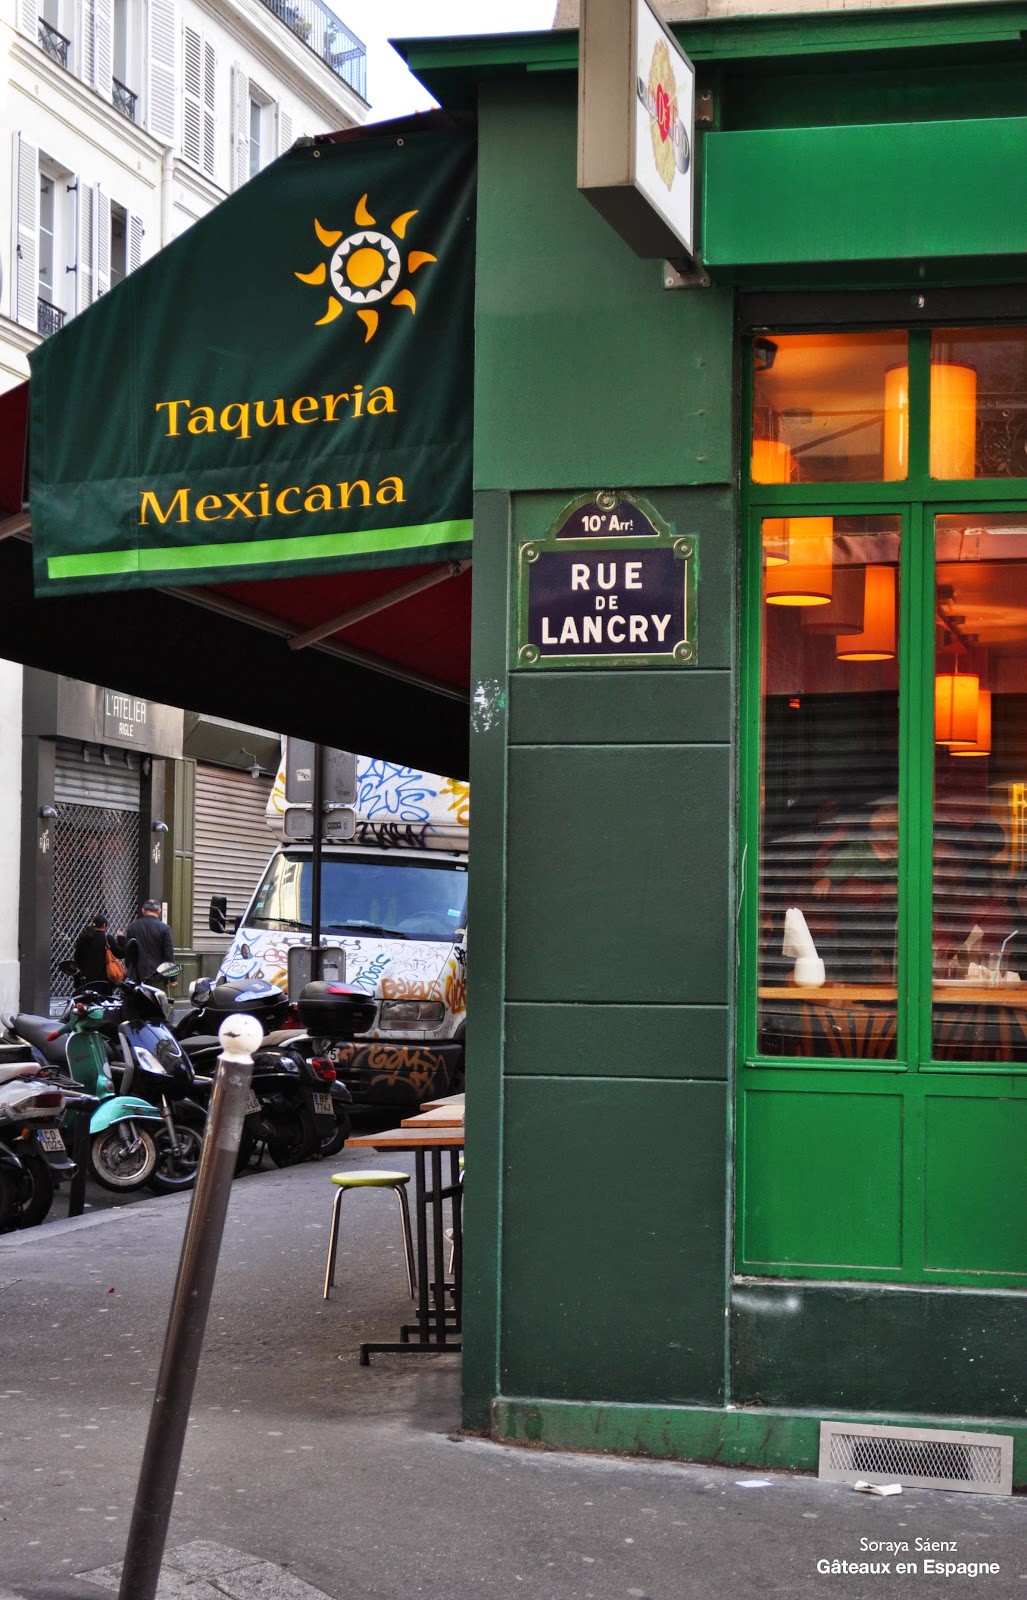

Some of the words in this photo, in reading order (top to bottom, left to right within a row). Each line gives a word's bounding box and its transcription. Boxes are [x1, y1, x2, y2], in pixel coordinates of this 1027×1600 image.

[156, 384, 398, 440] Taqueria
[138, 475, 407, 525] Mexicana
[571, 561, 643, 590] RUE
[595, 595, 619, 610] DE
[541, 614, 672, 645] LANCRY
[106, 694, 146, 723] L'ATELIER
[119, 723, 133, 737] AIGLE
